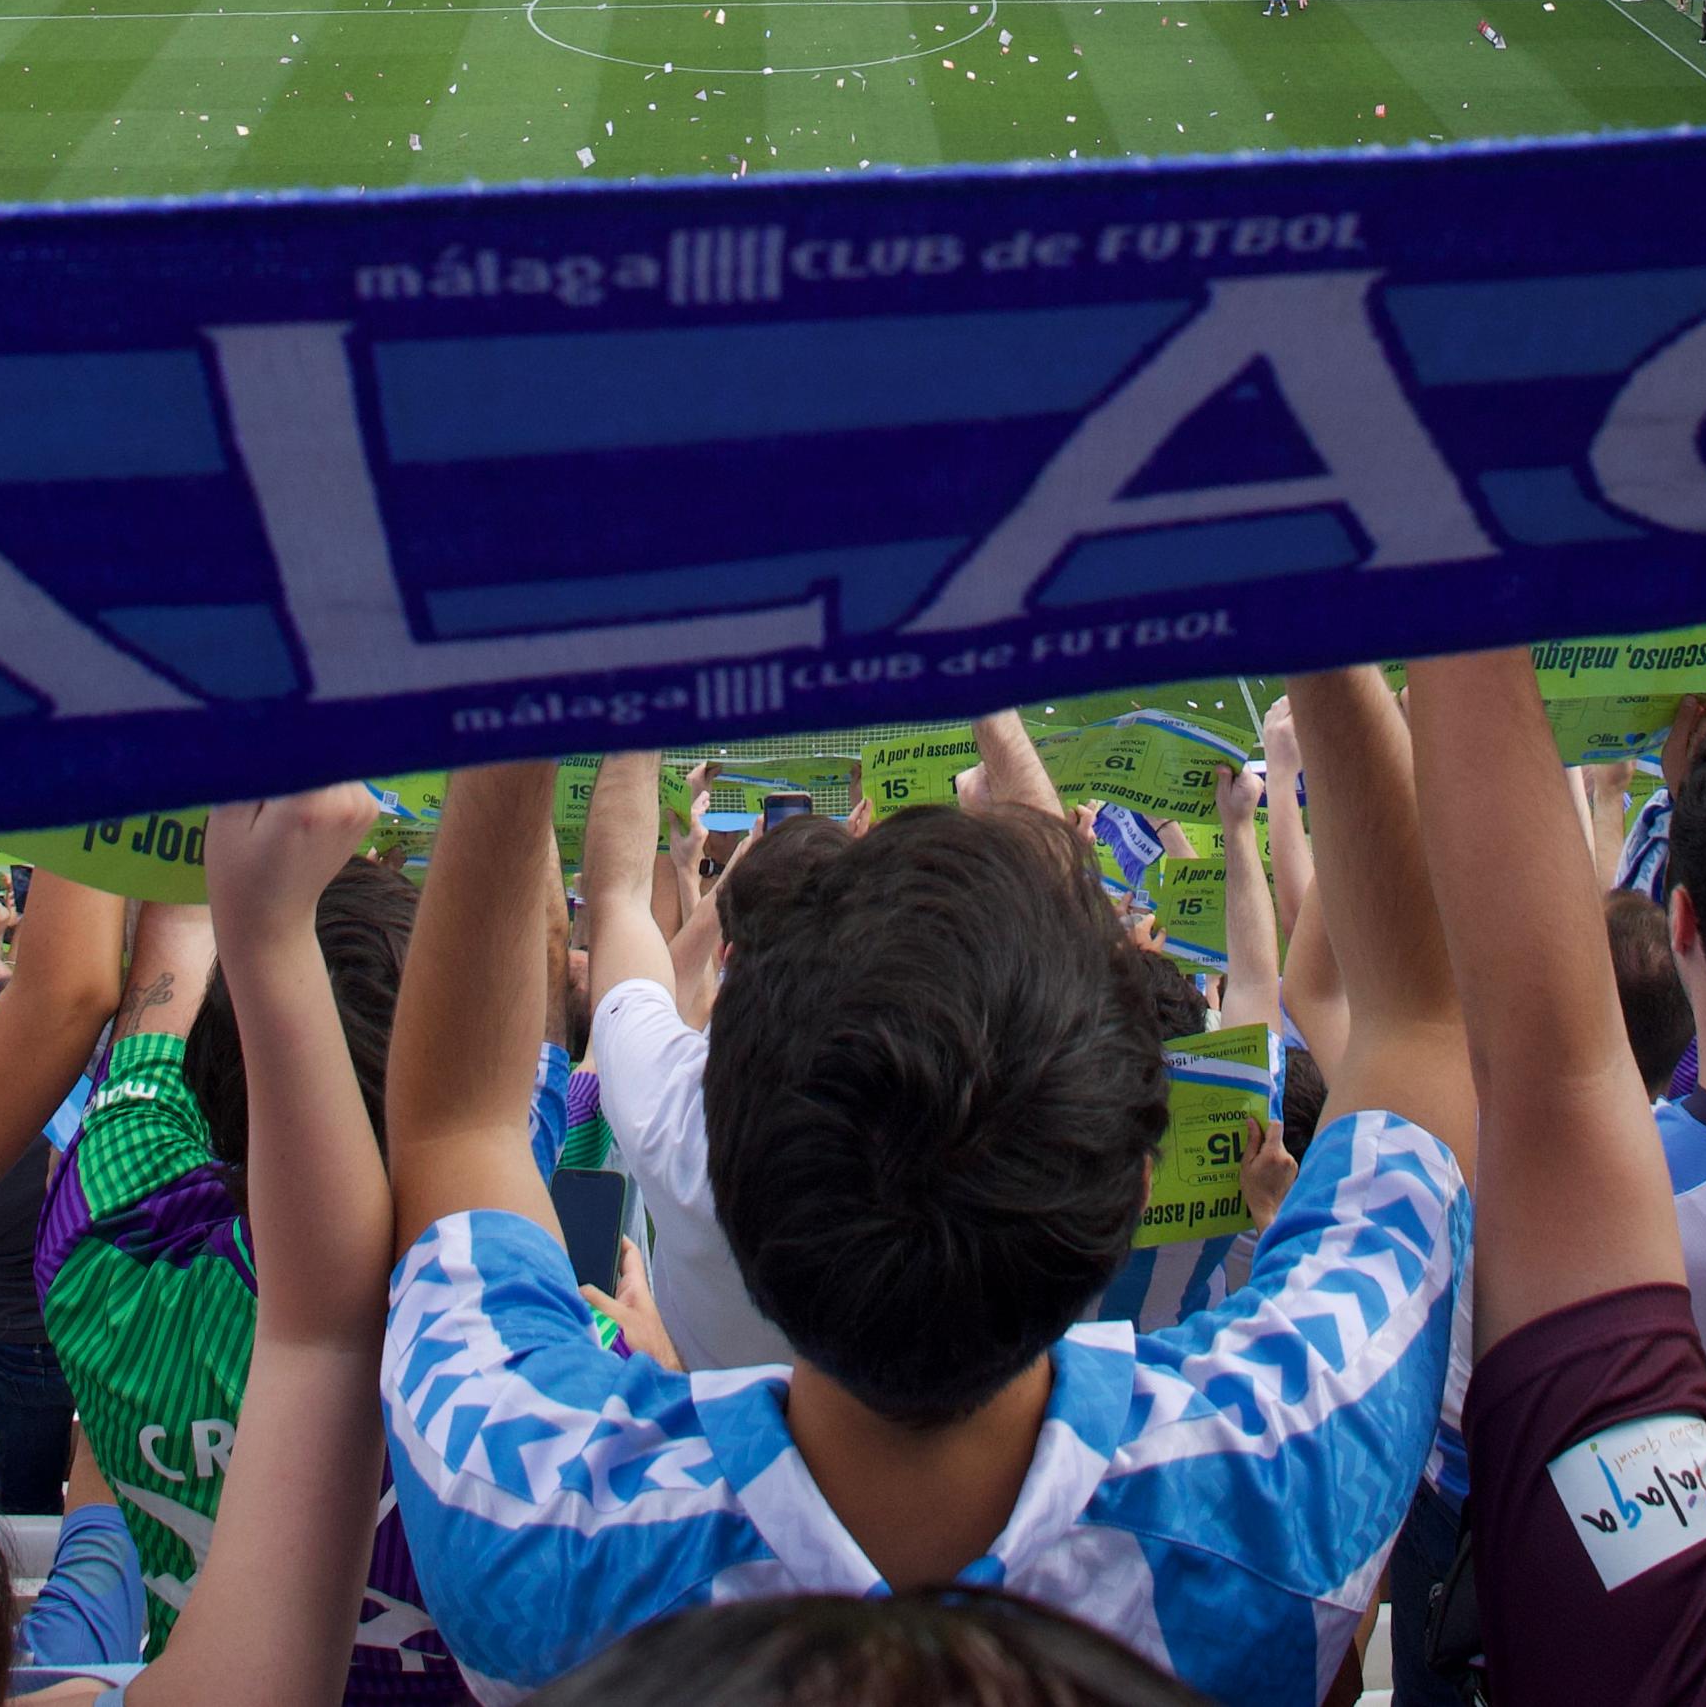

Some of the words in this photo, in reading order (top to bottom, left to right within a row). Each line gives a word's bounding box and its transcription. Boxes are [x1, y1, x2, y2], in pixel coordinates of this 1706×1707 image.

[355, 246, 661, 308] málaga
[789, 236, 963, 282] CLUB
[981, 231, 1081, 271] de
[1095, 212, 1366, 263] FUTBOL
[452, 685, 690, 733] málaga
[789, 655, 927, 692] CLUB
[939, 641, 1015, 676] de
[1029, 610, 1235, 662] FUTBOL
[1587, 733, 1619, 744] Olin
[871, 752, 886, 768] ¡A
[887, 748, 911, 767] por
[912, 742, 926, 759] el
[1104, 755, 1136, 772] 19
[1182, 769, 1214, 788] 15
[881, 779, 909, 799] 15
[1152, 795, 1167, 810] el
[1168, 801, 1198, 817] por
[1198, 800, 1217, 818] ¡A
[83, 820, 124, 852] el
[131, 813, 209, 866] por
[1173, 865, 1189, 885] ¡A
[1187, 868, 1213, 884] por
[1176, 898, 1203, 915] 15
[1207, 1109, 1248, 1124] 300Mb
[1207, 1131, 1244, 1166] 15
[1189, 1200, 1206, 1228] el
[1209, 1189, 1243, 1219] por
[138, 1417, 239, 1484] CR
